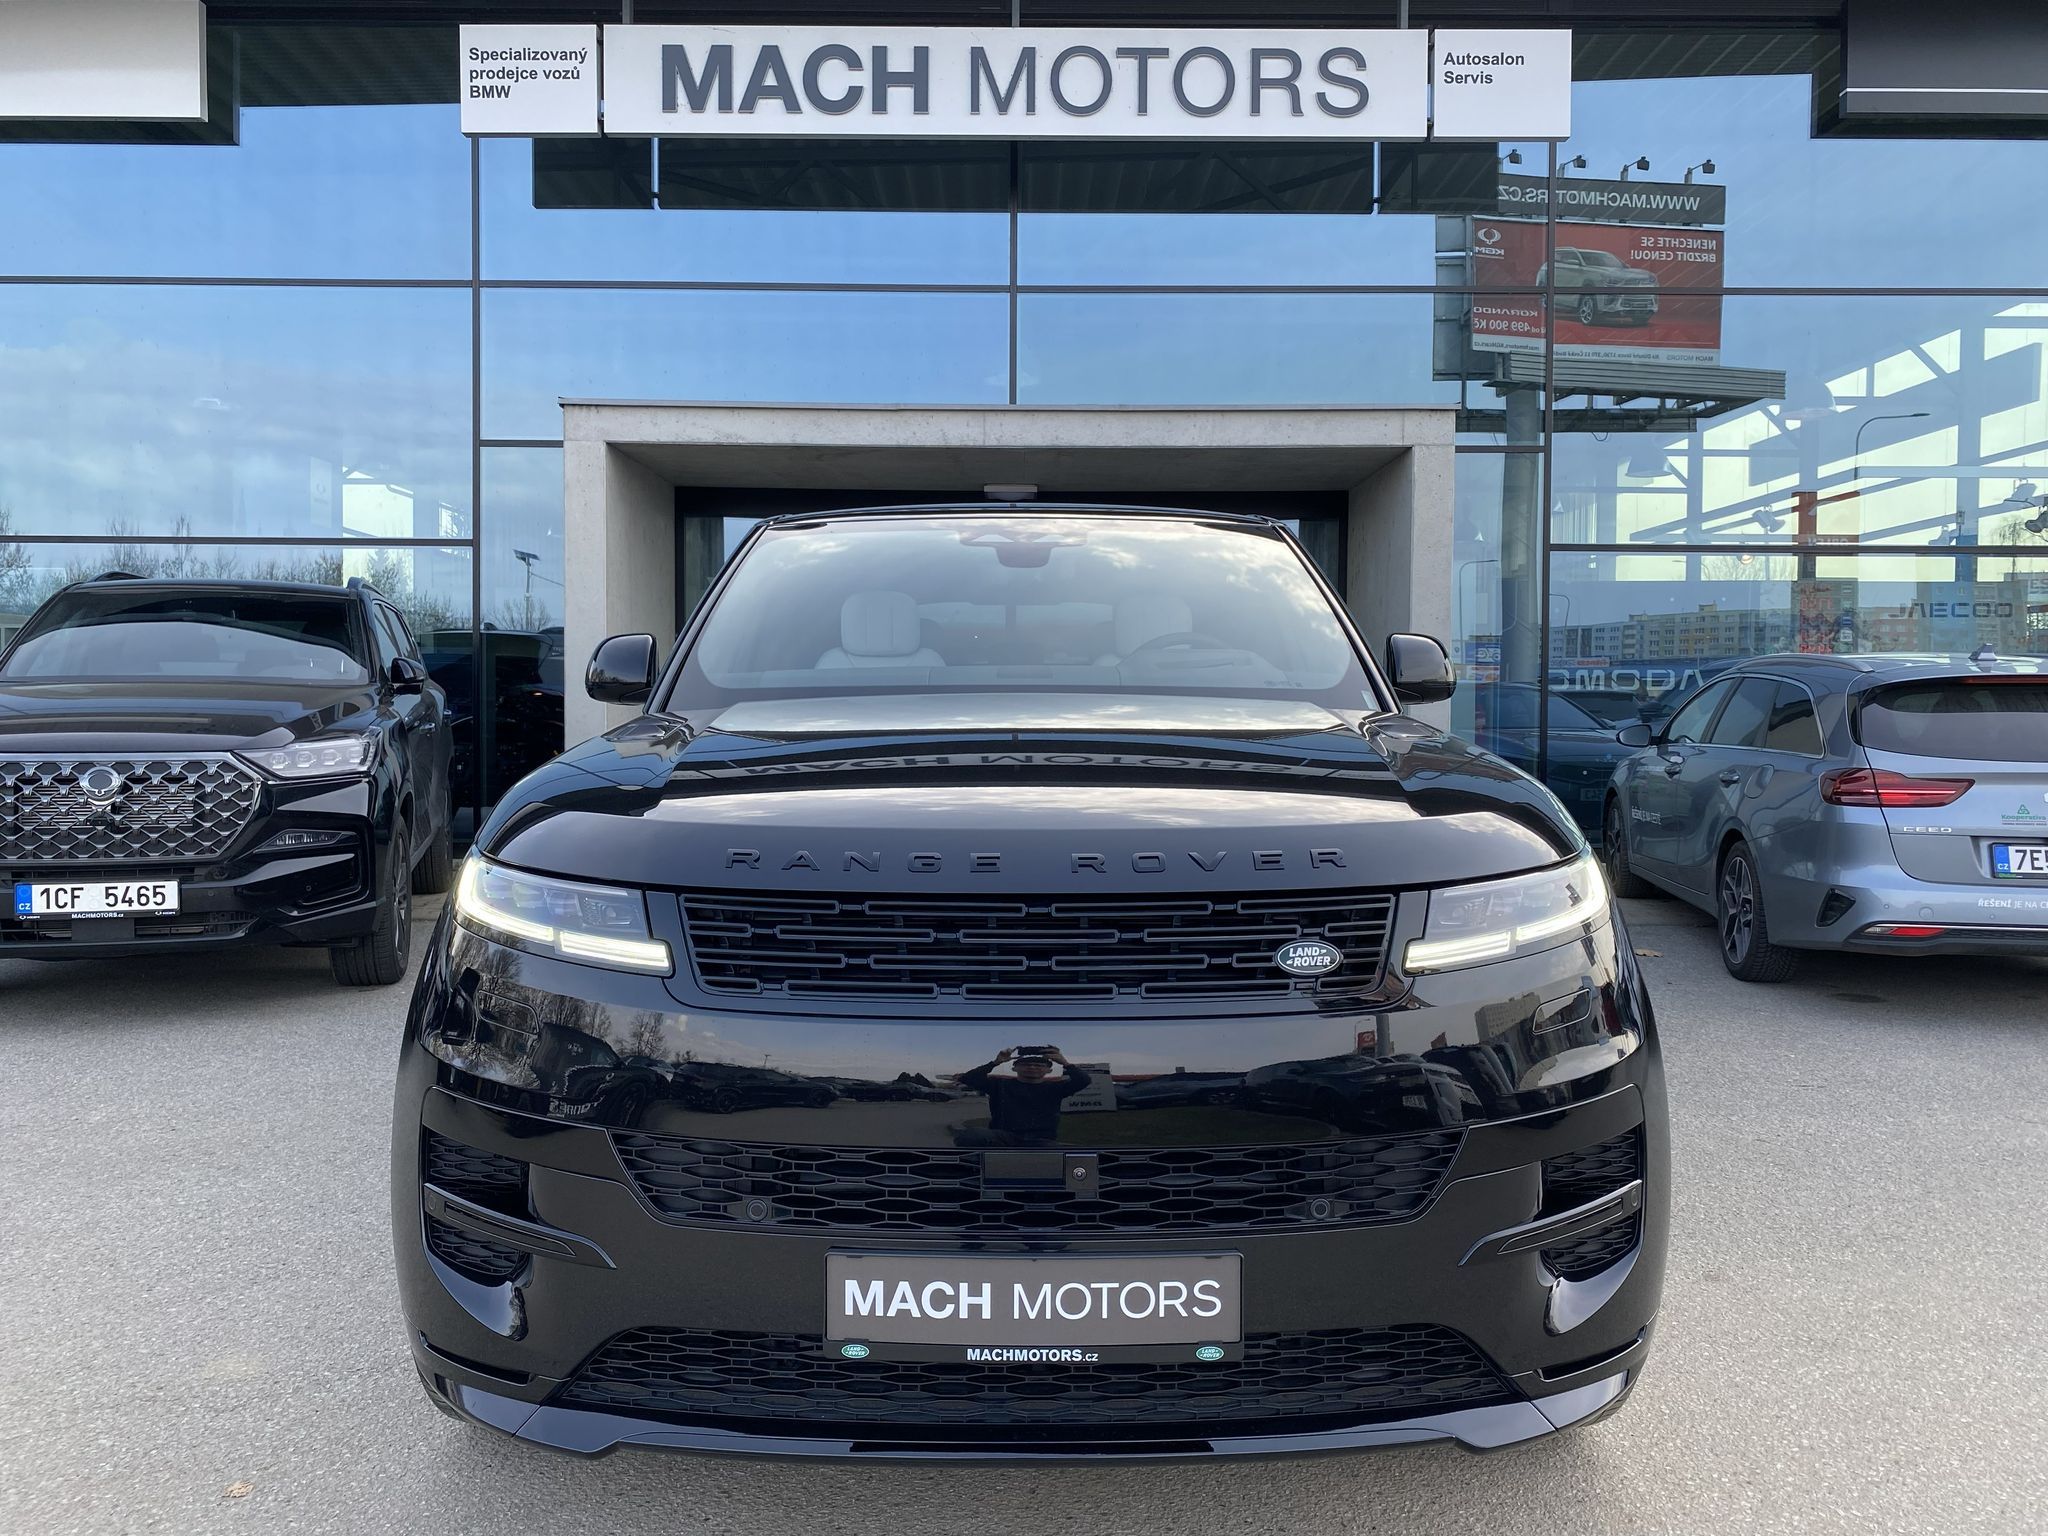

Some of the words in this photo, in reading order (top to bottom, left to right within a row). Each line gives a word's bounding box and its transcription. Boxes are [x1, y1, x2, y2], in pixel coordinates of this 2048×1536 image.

[469, 47, 588, 64] Specializovaný
[1443, 52, 1525, 66] Autosalon
[469, 66, 538, 83] prodejce
[543, 65, 580, 80] vozů
[661, 43, 930, 116] MACH
[969, 45, 1370, 117] MOTORS
[1443, 71, 1493, 84] Servis
[469, 85, 511, 99] BMW
[724, 847, 1003, 873] RANGE
[1071, 847, 1348, 873] ROVER
[2015, 849, 2048, 871] 7E
[19, 902, 31, 910] CZ
[40, 887, 85, 909] 1CF
[104, 884, 166, 907] 5465
[2013, 900, 2023, 909] JE
[2025, 900, 2038, 909] NA
[1289, 946, 1320, 957] LAND
[1293, 956, 1331, 967] ROVER
[844, 1279, 992, 1320] MACH
[1013, 1280, 1223, 1320] MOTORS
[966, 1348, 1099, 1363] MACHMOTORS.cz
